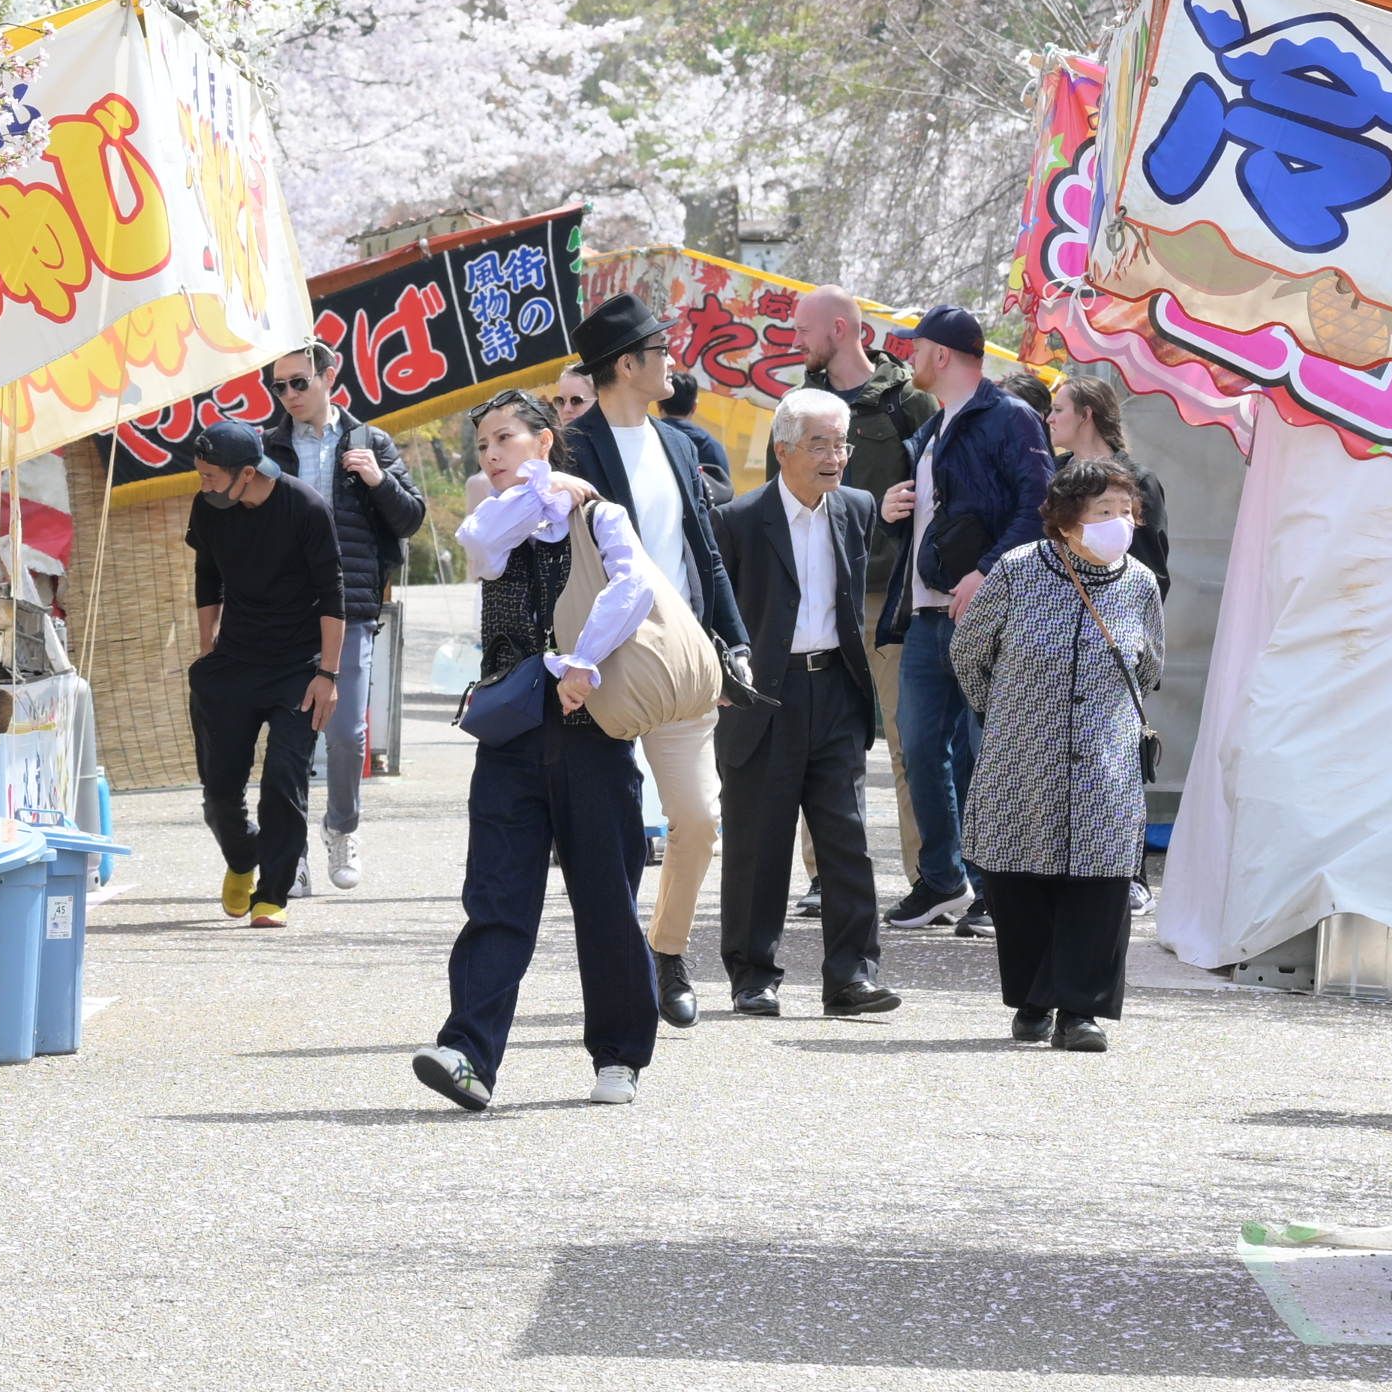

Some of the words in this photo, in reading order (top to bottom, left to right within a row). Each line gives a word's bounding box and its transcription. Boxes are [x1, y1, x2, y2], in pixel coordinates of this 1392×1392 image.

[463, 249, 521, 366] 風物詩
[502, 244, 556, 337] 街の
